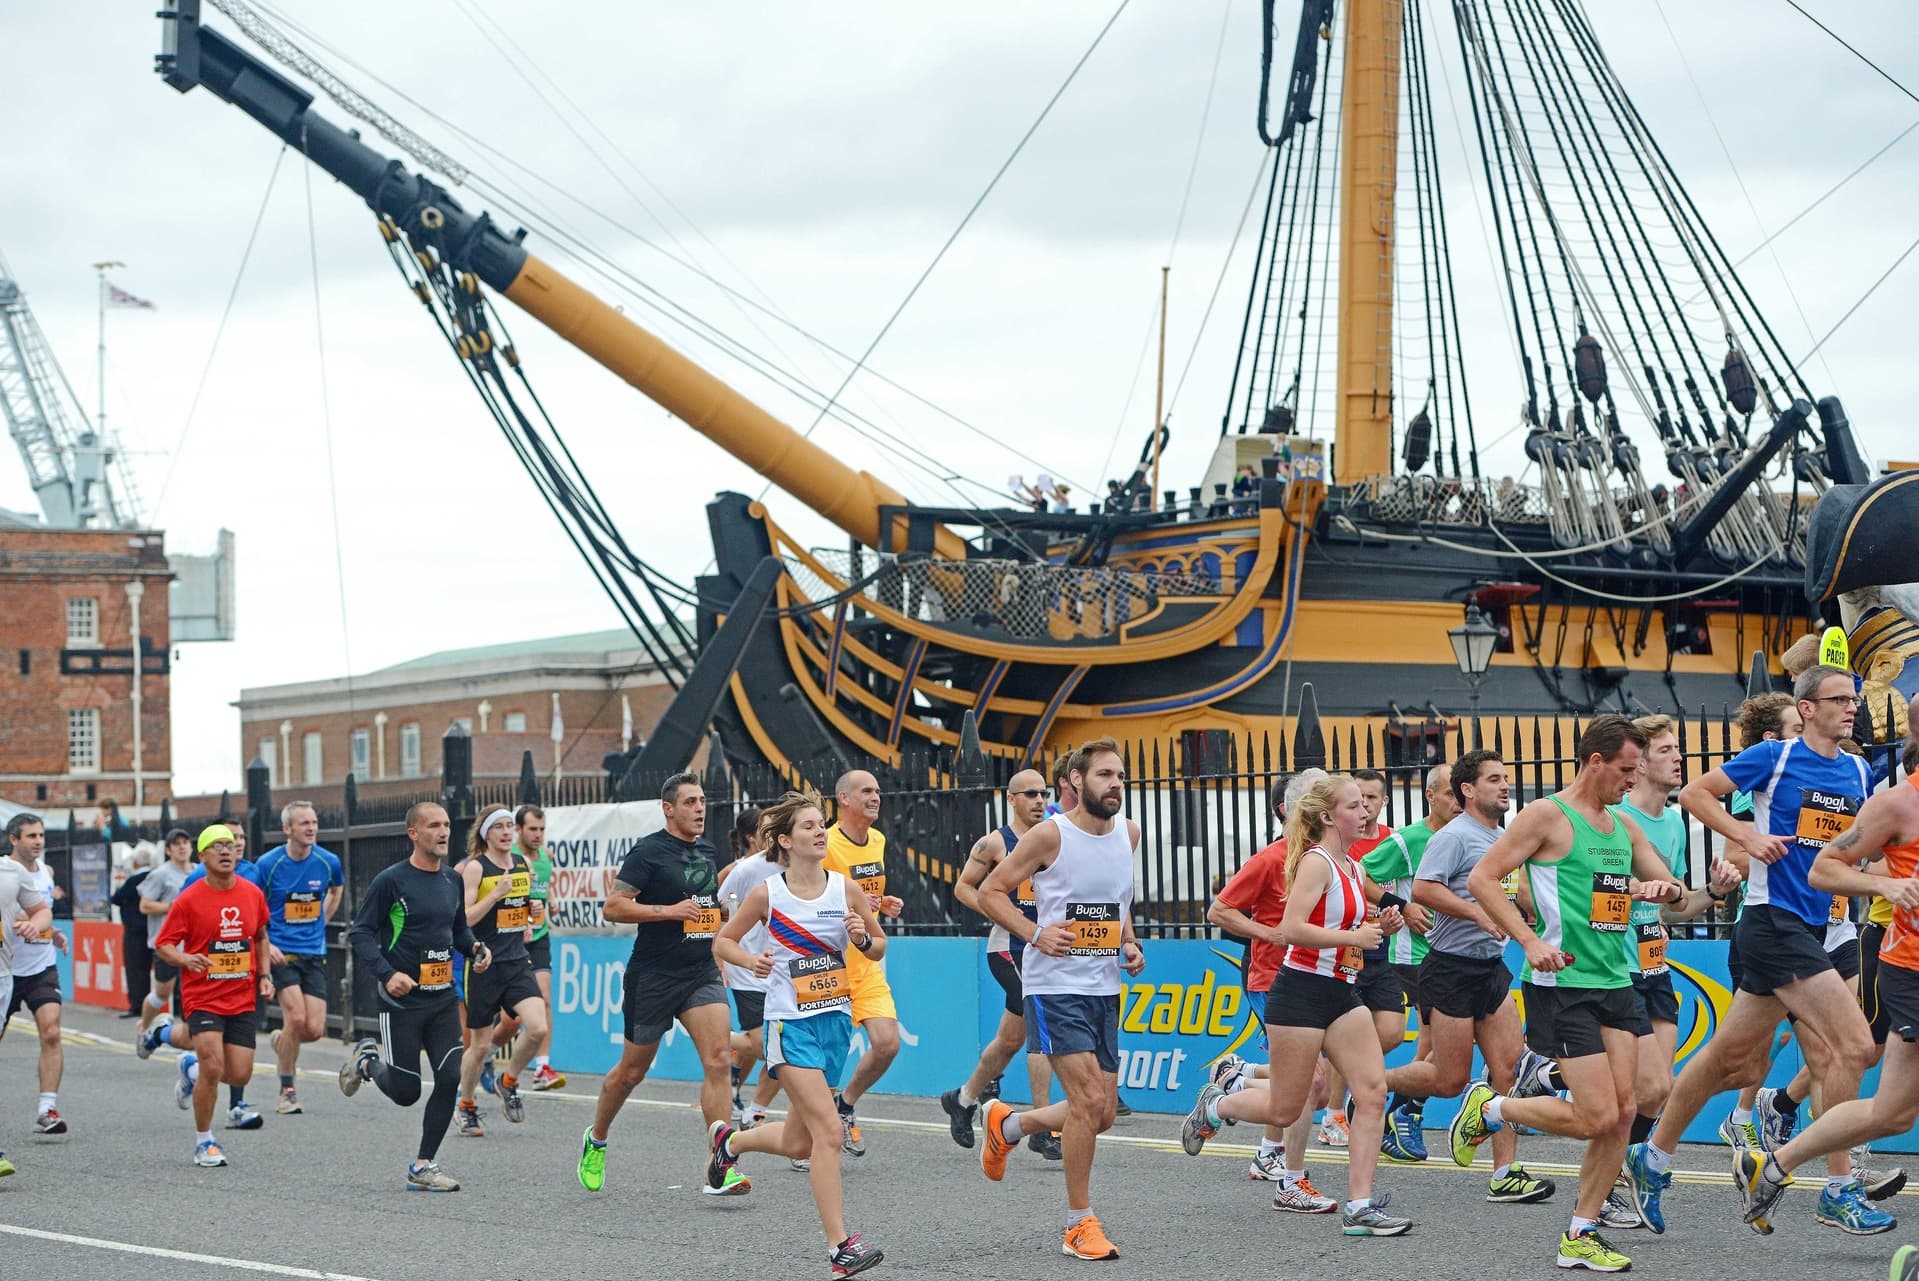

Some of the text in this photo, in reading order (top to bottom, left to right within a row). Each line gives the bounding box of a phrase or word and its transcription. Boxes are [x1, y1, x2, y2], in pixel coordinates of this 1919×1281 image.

[1826, 649, 1845, 665] PACER
[1812, 792, 1841, 810] Bupa
[1815, 817, 1842, 832] 1704
[548, 839, 600, 868] ROYAL
[1602, 858, 1624, 866] GREEN
[856, 865, 876, 875] Bupa
[549, 869, 618, 898] ROYAL M
[861, 882, 879, 892] 3412
[1603, 875, 1625, 891] Bupa
[1076, 904, 1104, 919] Bupa
[1079, 927, 1108, 939] 1439
[1643, 924, 1661, 938] Bupa
[215, 941, 241, 952] Bupa
[1070, 948, 1118, 956] ORTSMOUTH
[427, 950, 449, 961] Bupa
[798, 955, 829, 970] Bupa
[558, 943, 626, 1033] Bup
[809, 976, 838, 992] 6565
[800, 996, 850, 1011] PORTSMOUTH
[1119, 968, 1242, 1036] zade
